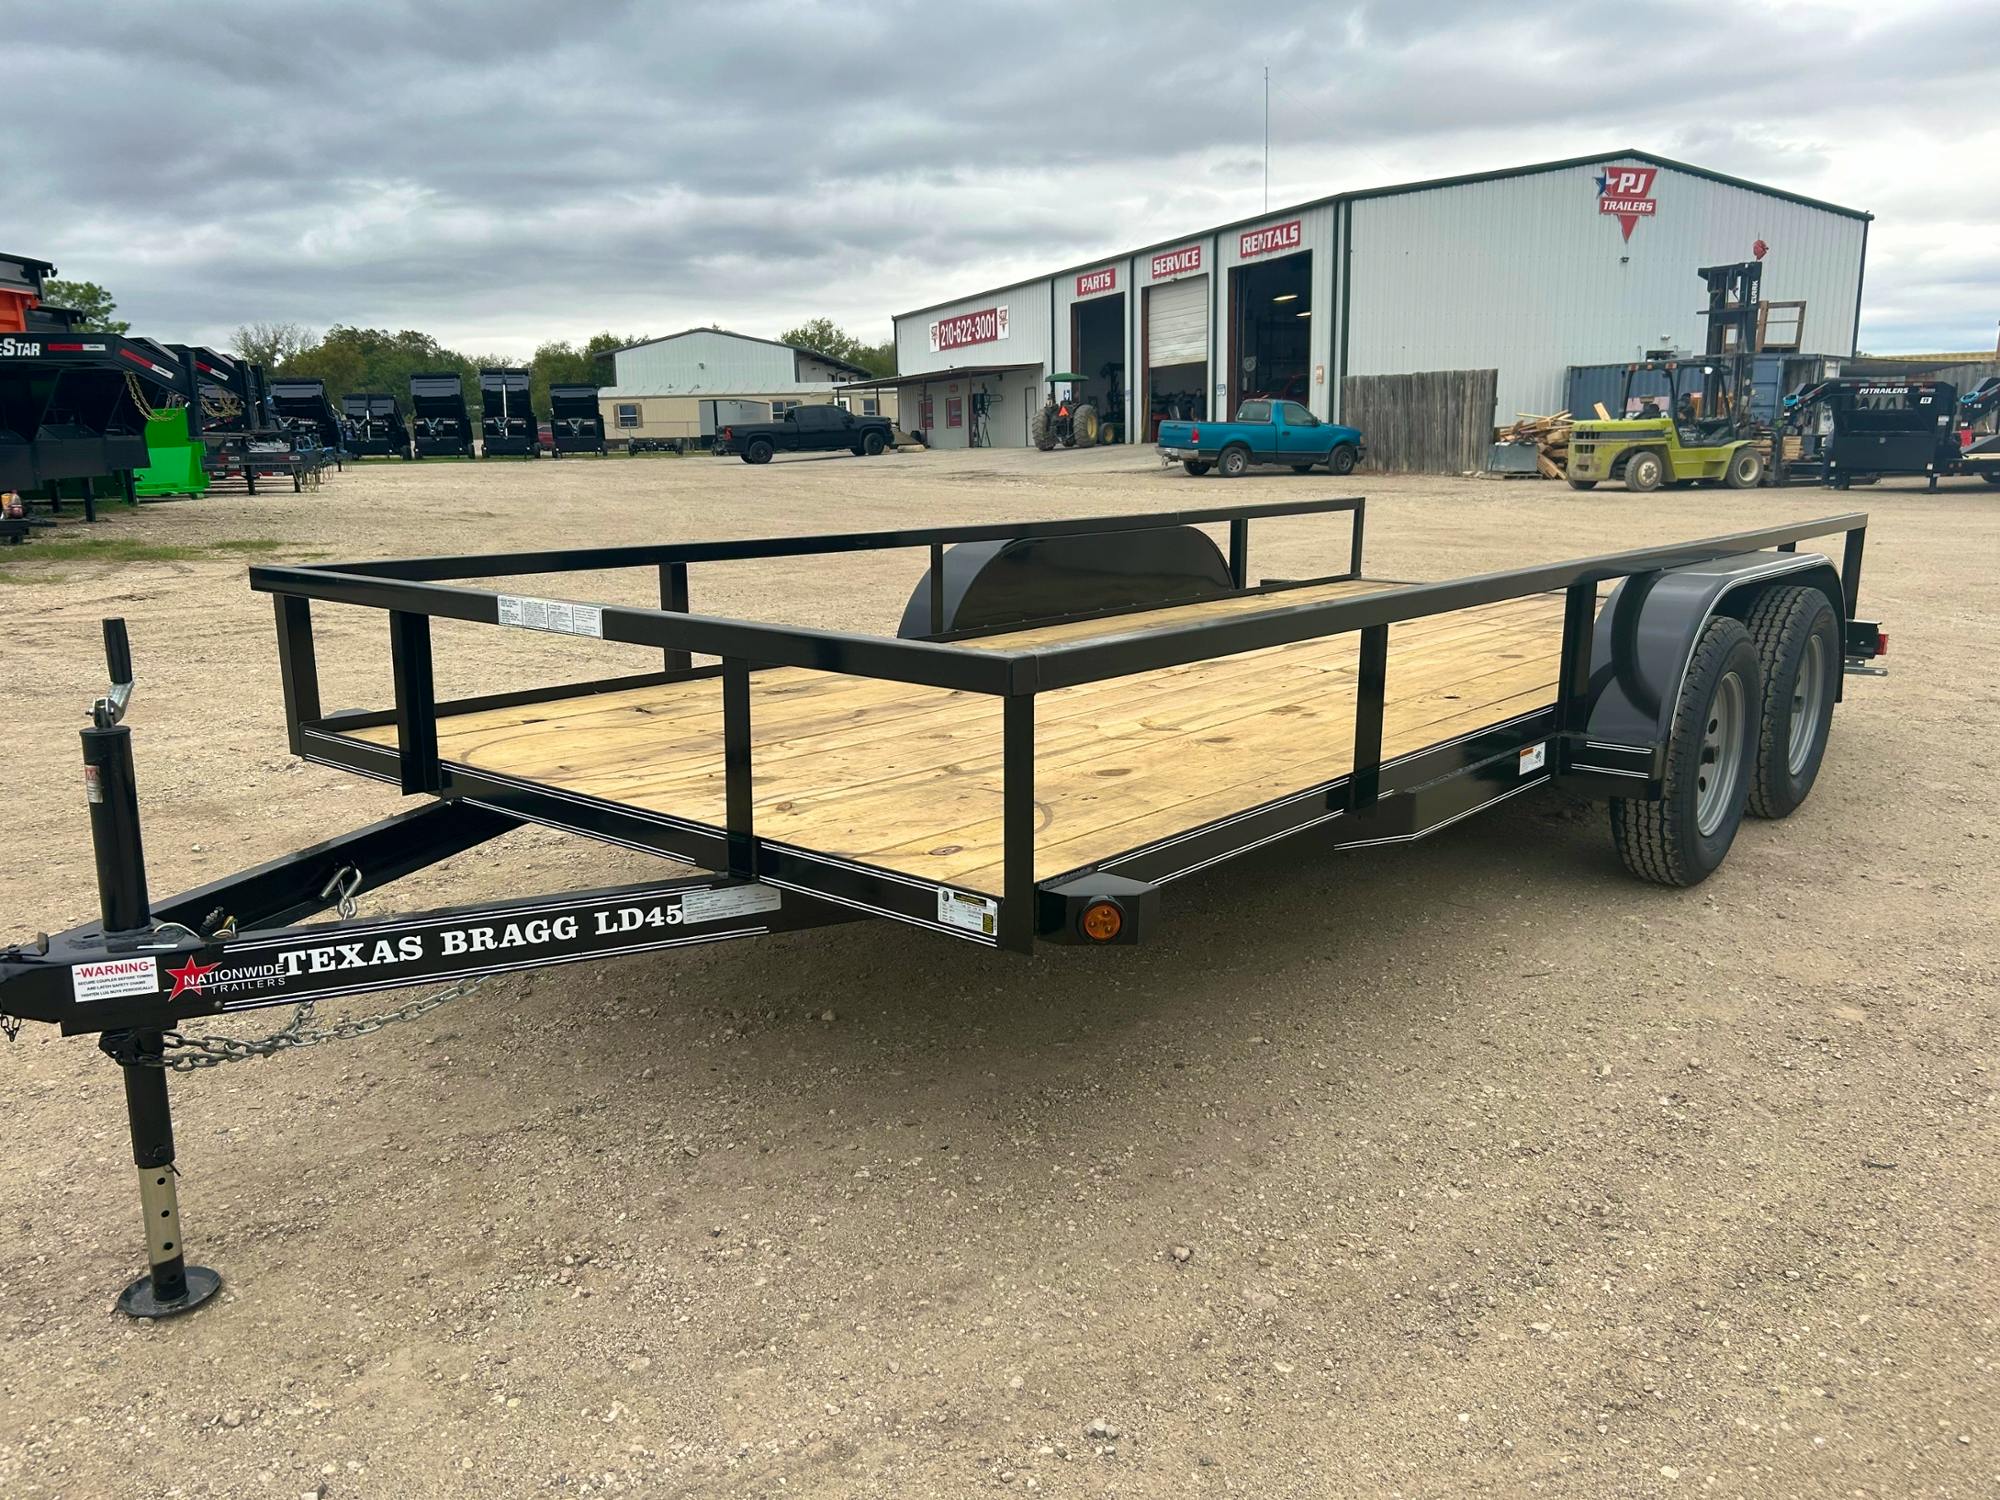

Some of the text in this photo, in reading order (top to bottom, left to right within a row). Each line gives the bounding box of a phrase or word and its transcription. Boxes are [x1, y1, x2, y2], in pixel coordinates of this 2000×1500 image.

[1617, 173, 1647, 193] PJ
[1603, 201, 1654, 212] TRAILERS
[1241, 225, 1299, 254] RENTALS
[1153, 249, 1199, 275] SERVICE
[1081, 272, 1111, 292] PARTS
[1750, 280, 1759, 304] CLARK
[940, 313, 996, 346] 210-622-3001
[0, 338, 40, 356] STAR
[278, 903, 683, 976] TEXAS BRAGG LD45
[184, 963, 285, 986] NATIONWIDE
[212, 977, 286, 995] TRAILERS
